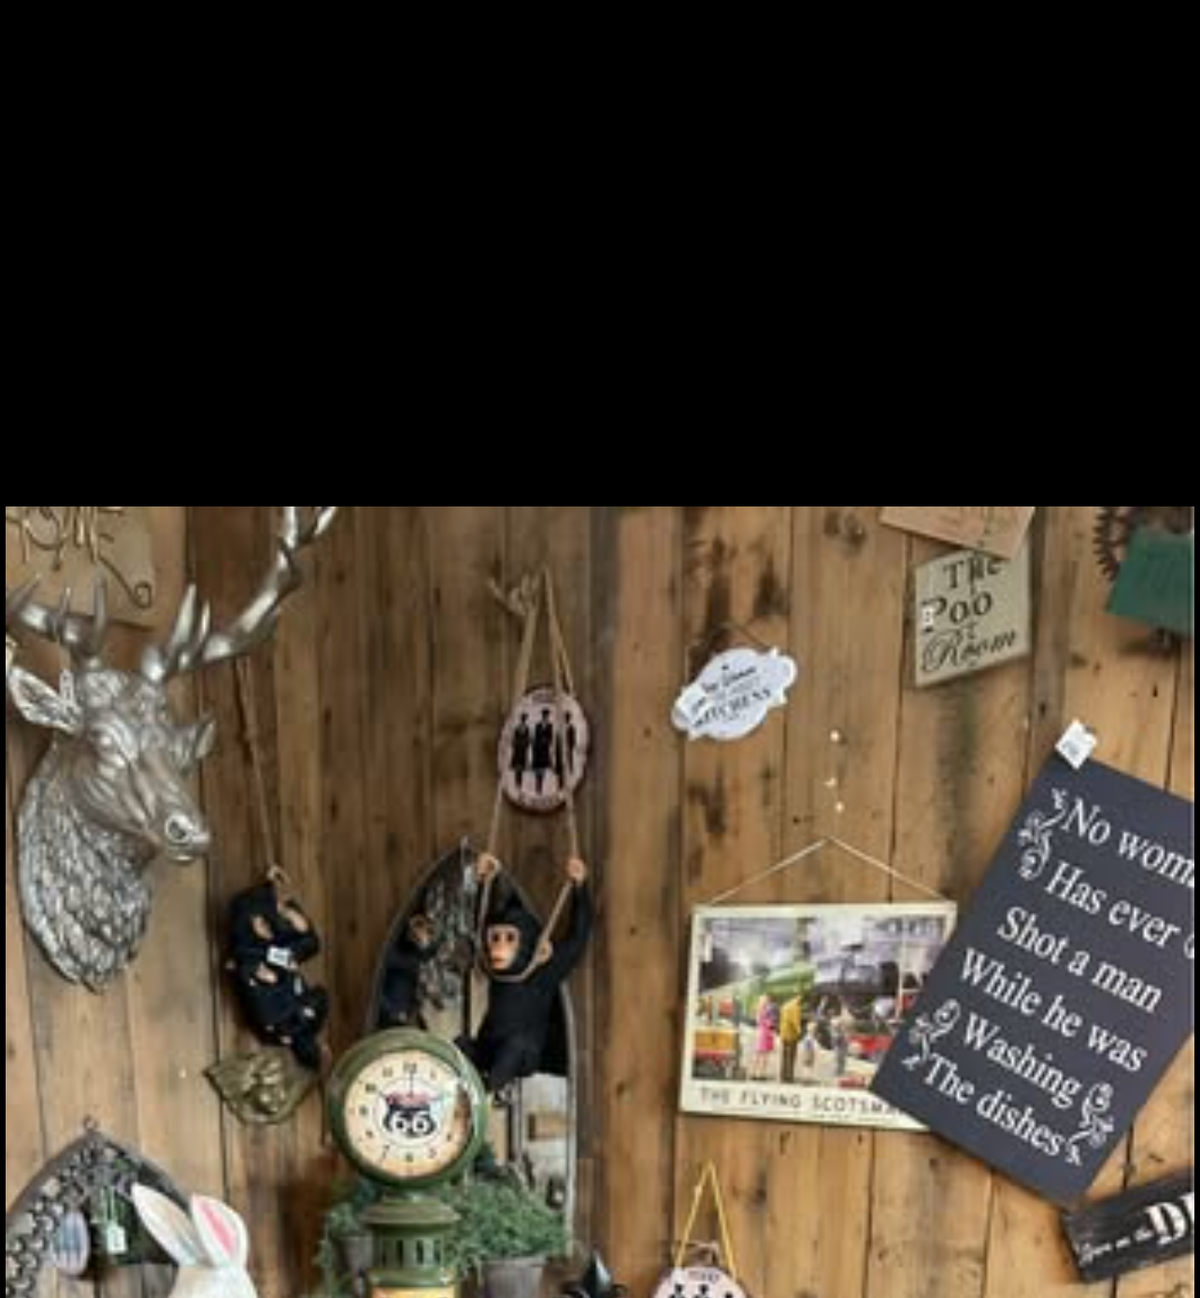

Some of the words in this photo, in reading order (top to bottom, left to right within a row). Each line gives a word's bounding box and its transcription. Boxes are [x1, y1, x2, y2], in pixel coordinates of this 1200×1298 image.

[920, 590, 992, 633] Poo
[1060, 797, 1111, 846] No
[1118, 831, 1194, 888] wom
[1045, 859, 1107, 915] Has
[1108, 900, 1181, 949] ever
[997, 905, 1069, 964] Shot
[1067, 950, 1090, 976] a
[1091, 960, 1163, 1013] man
[960, 947, 1042, 1016] While
[1041, 994, 1083, 1037] he
[1087, 1024, 1148, 1072] was
[701, 1087, 730, 1105] THE
[741, 1089, 800, 1109] FLYING
[924, 1052, 975, 1103] The
[976, 1090, 1066, 1156] dishes
[963, 1012, 1083, 1109] Washing
[389, 1112, 430, 1133] 66
